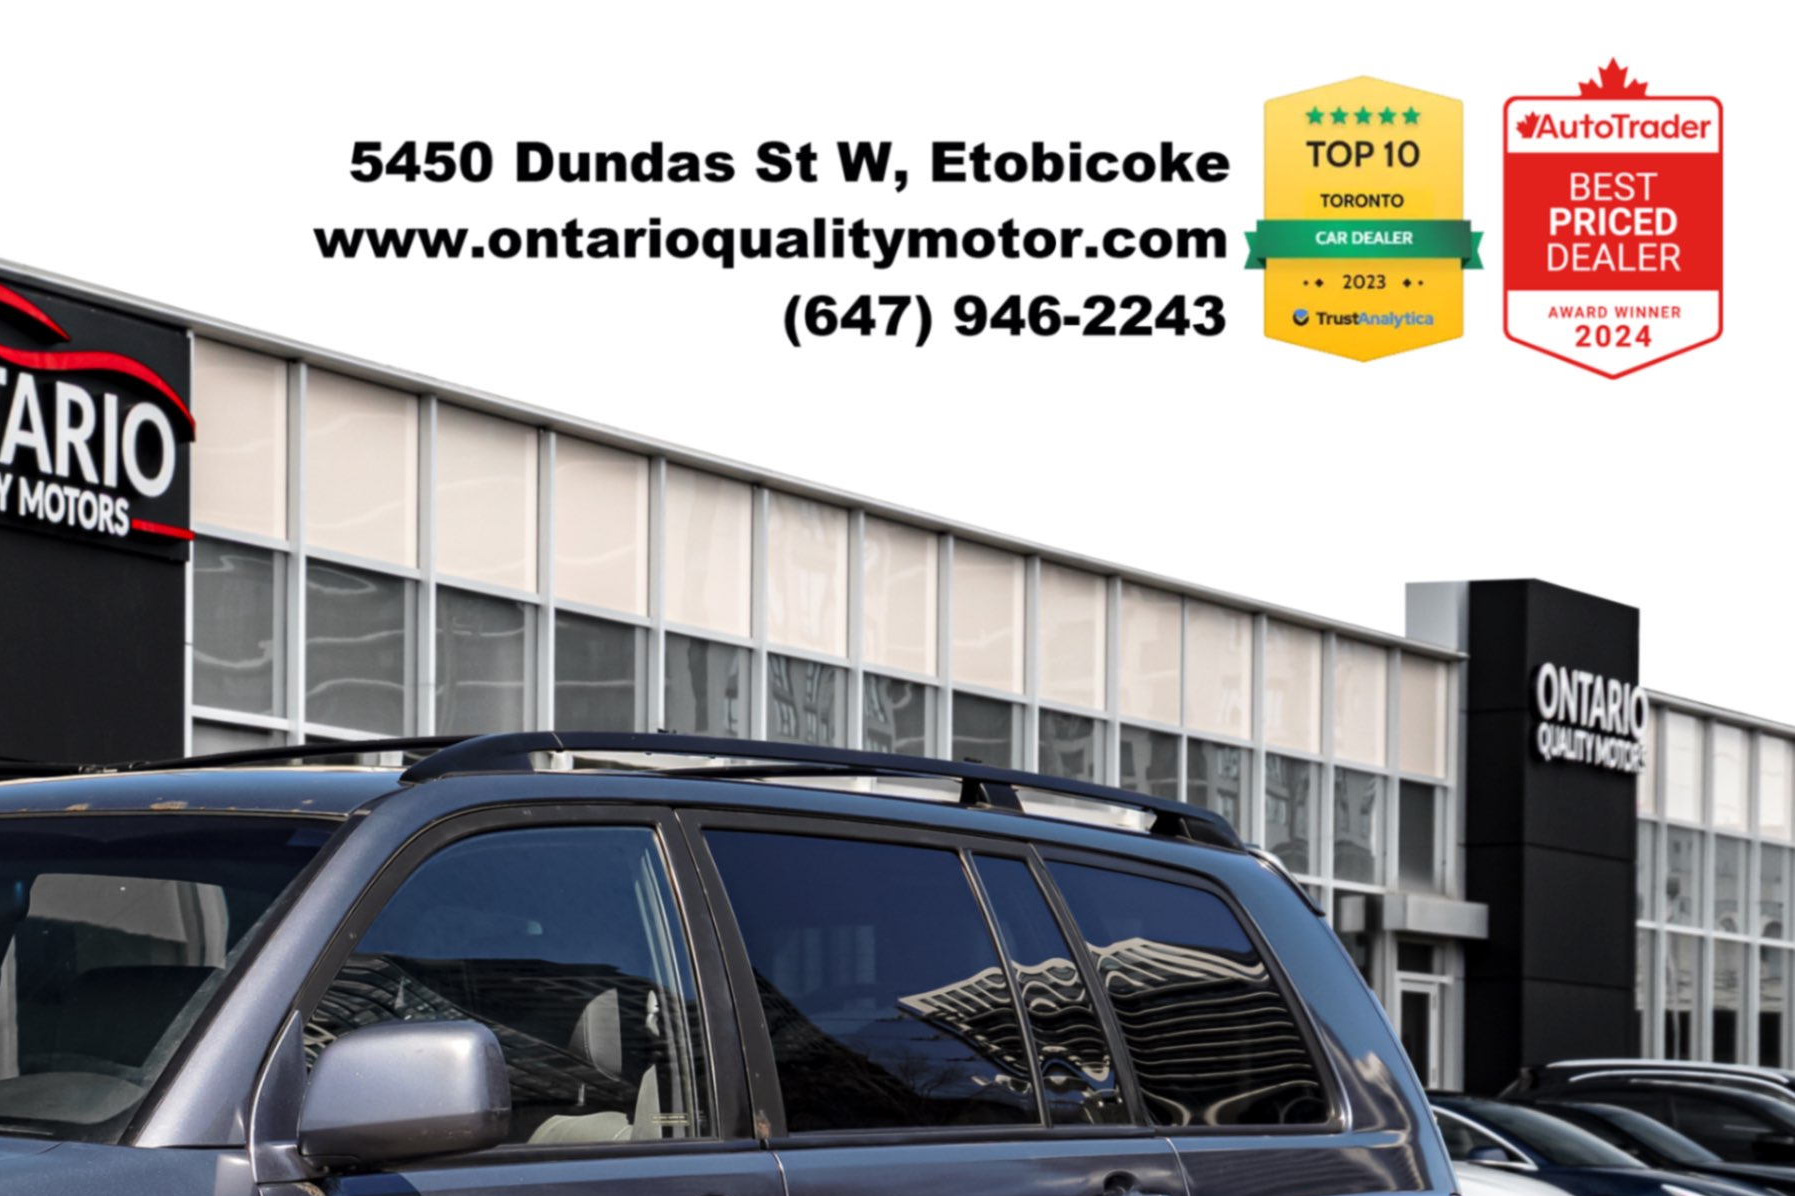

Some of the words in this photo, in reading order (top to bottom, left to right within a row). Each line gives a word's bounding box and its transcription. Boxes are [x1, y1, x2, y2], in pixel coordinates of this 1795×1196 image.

[18, 476, 131, 536] MOTORS
[1536, 661, 1649, 741] ONTARIO
[1537, 721, 1595, 763] QUALITY
